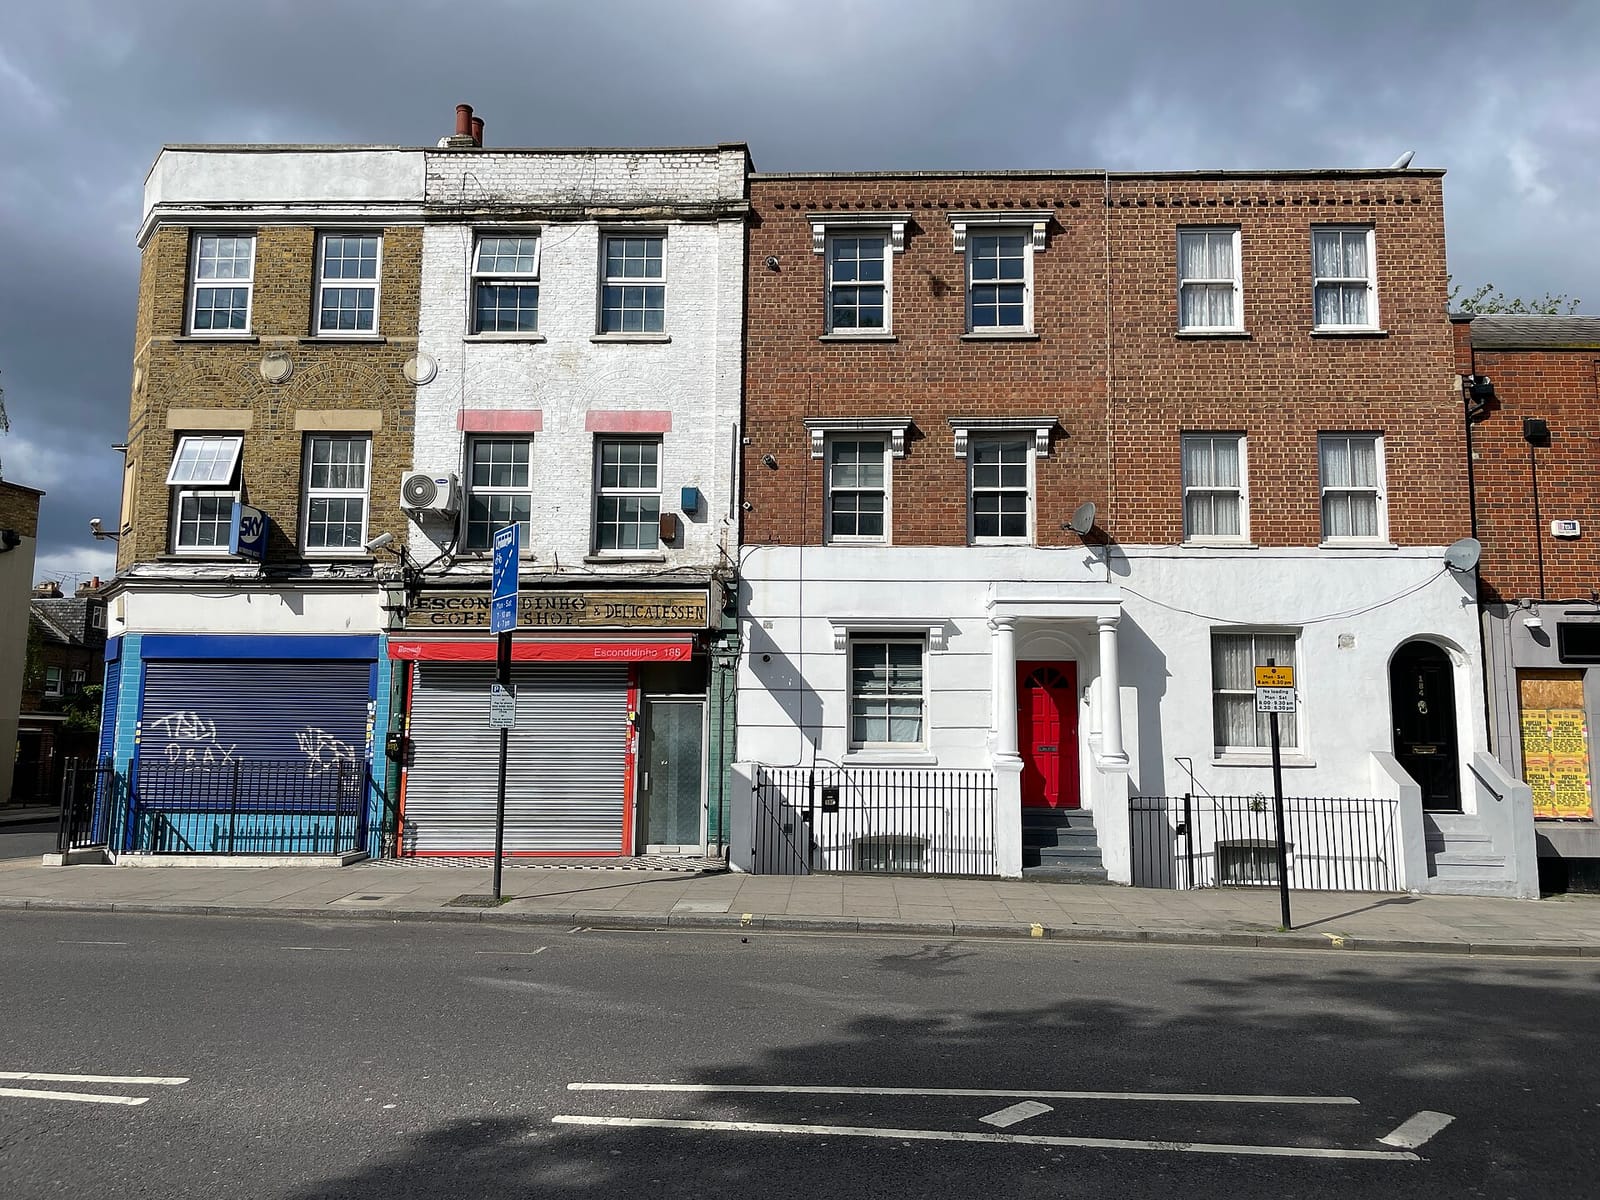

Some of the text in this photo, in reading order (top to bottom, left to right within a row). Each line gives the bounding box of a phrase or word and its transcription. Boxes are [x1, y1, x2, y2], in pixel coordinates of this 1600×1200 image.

[240, 516, 263, 537] SKY
[416, 598, 586, 610] ESCONDINHO
[431, 612, 573, 625] COFF SHOP
[605, 604, 704, 620] DELICATESSEN
[594, 648, 658, 657] Escondidinho
